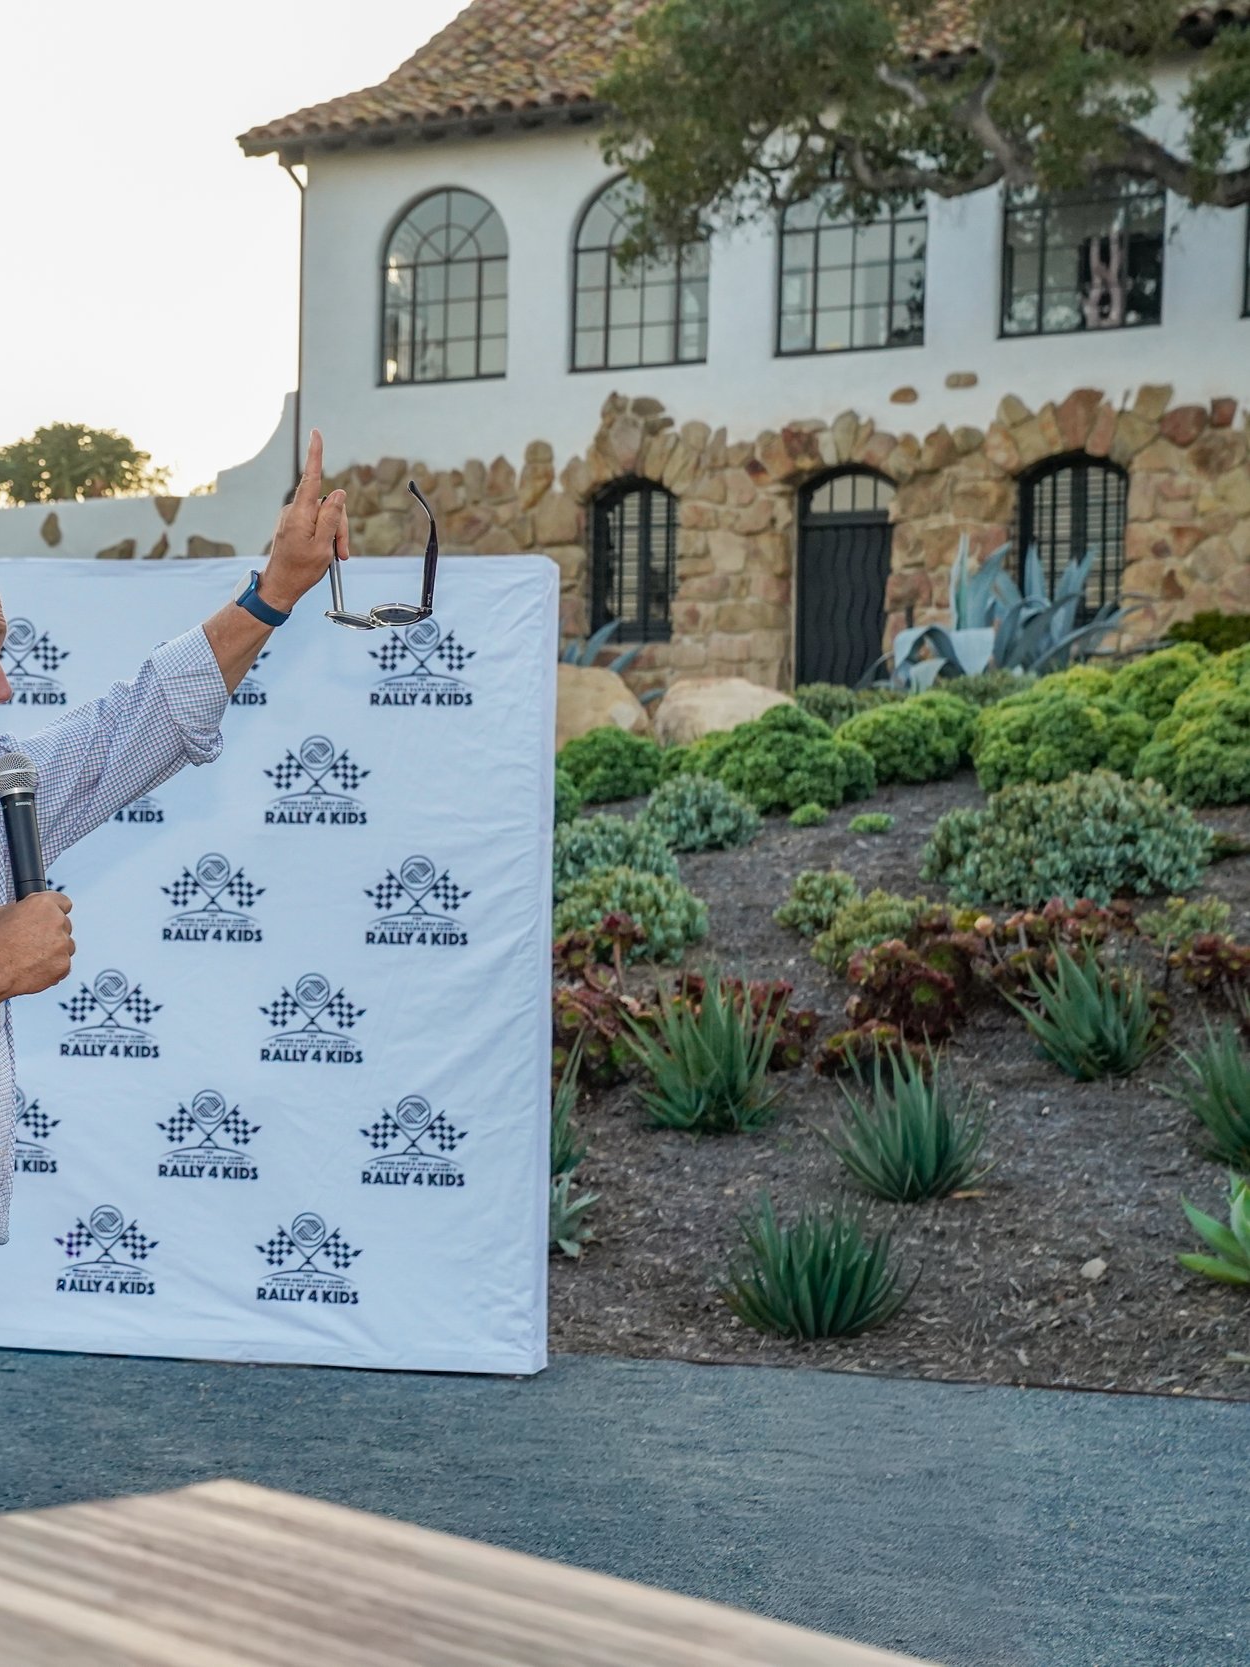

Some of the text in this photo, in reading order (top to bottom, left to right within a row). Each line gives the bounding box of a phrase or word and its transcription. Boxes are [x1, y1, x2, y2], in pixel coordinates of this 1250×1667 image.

[17, 692, 28, 705] 4
[32, 692, 67, 705] KIDS
[230, 692, 267, 706] KIDS
[369, 692, 473, 706] RALLY 4 KIDS
[113, 810, 164, 824] 4 KIDS
[264, 811, 368, 825] RALLY 4 KIDS
[162, 928, 263, 943] RALLY 4 KIDS
[365, 931, 469, 946] RALLY 4 KIDS
[60, 1043, 160, 1059] RALLY 4 KIDS
[260, 1048, 364, 1064] RALLY 4 KIDS
[22, 1159, 57, 1173] KIDS
[158, 1162, 259, 1180] RALLY 4 KIDS
[361, 1170, 465, 1188] RALLY 4 KIDS
[56, 1278, 156, 1295] RALLY 4 KIDS
[256, 1286, 359, 1304] RALLY 4 KIDS
